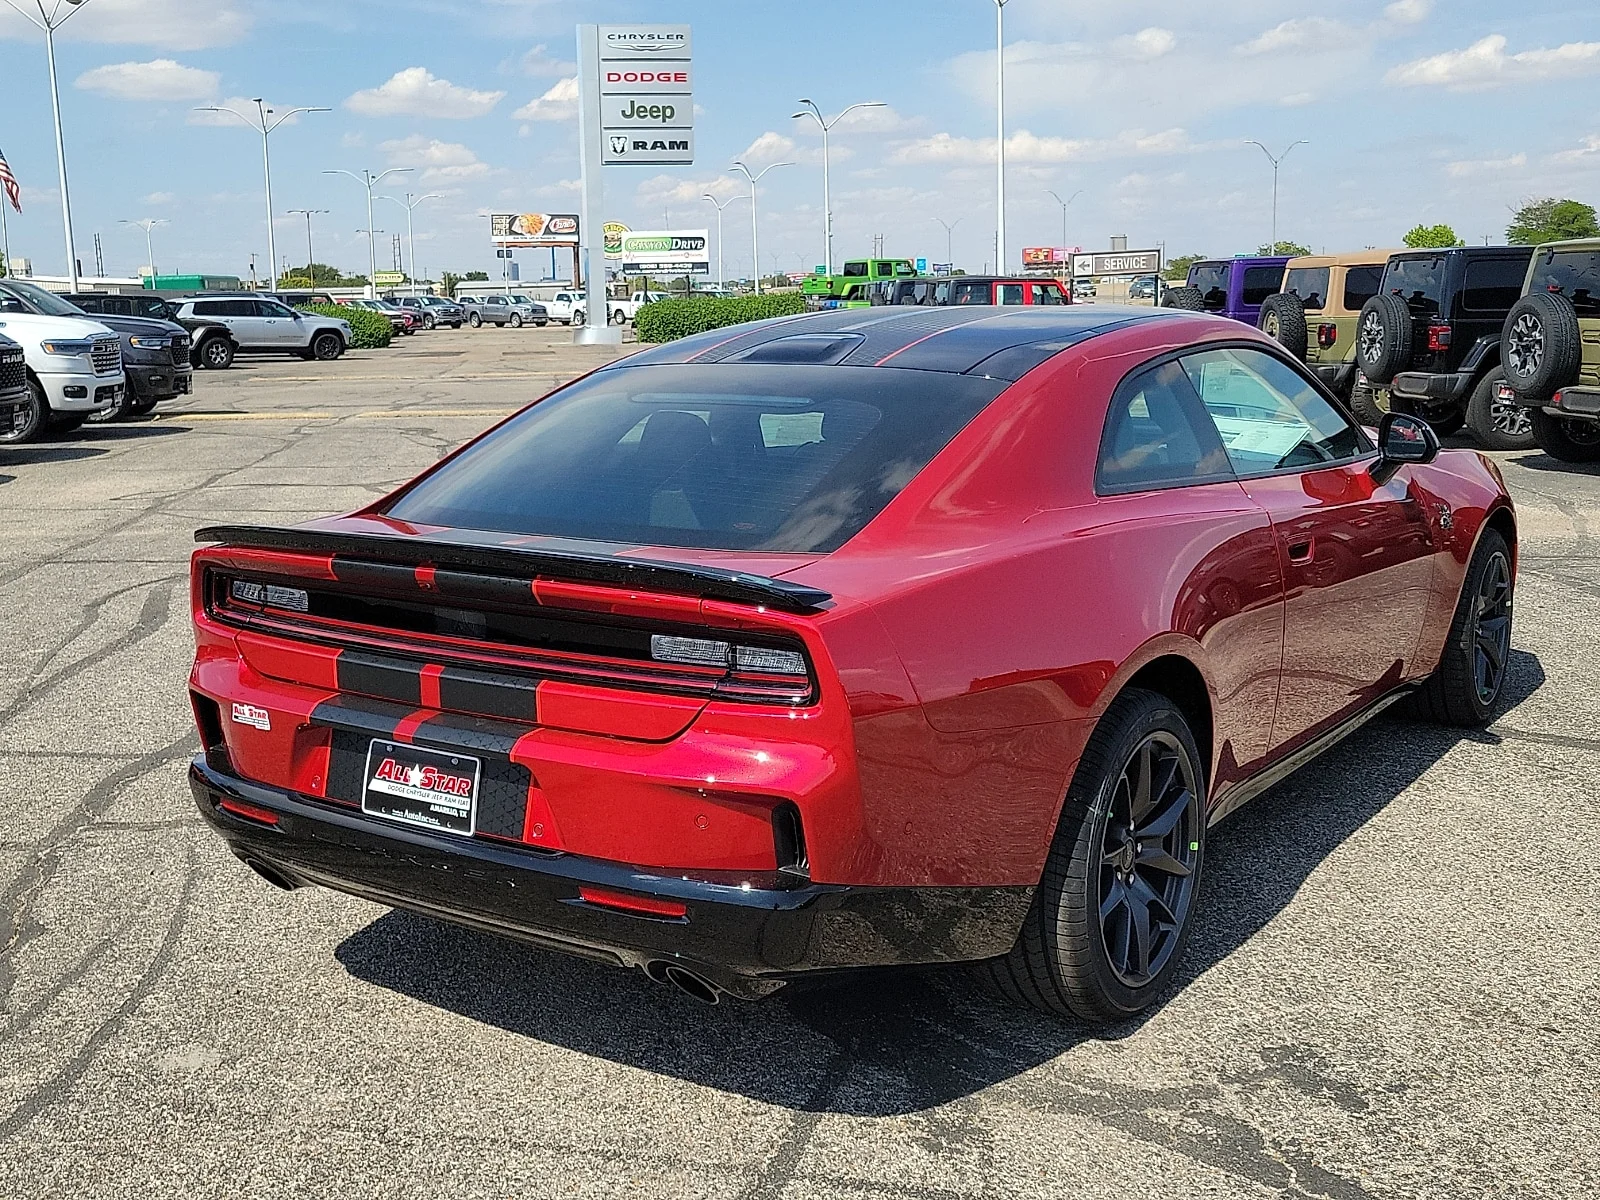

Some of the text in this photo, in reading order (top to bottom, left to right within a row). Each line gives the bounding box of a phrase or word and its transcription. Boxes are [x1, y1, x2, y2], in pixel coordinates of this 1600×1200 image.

[607, 72, 688, 83] DODGE
[621, 100, 675, 123] Jeep
[633, 140, 689, 151] RAM
[627, 238, 704, 251] CANYON DRIVE
[1103, 256, 1147, 271] SERVICE
[248, 707, 267, 719] STAR
[375, 758, 472, 797] ALL STAR
[387, 784, 406, 794] DODGE
[406, 788, 431, 799] CHRYSLER
